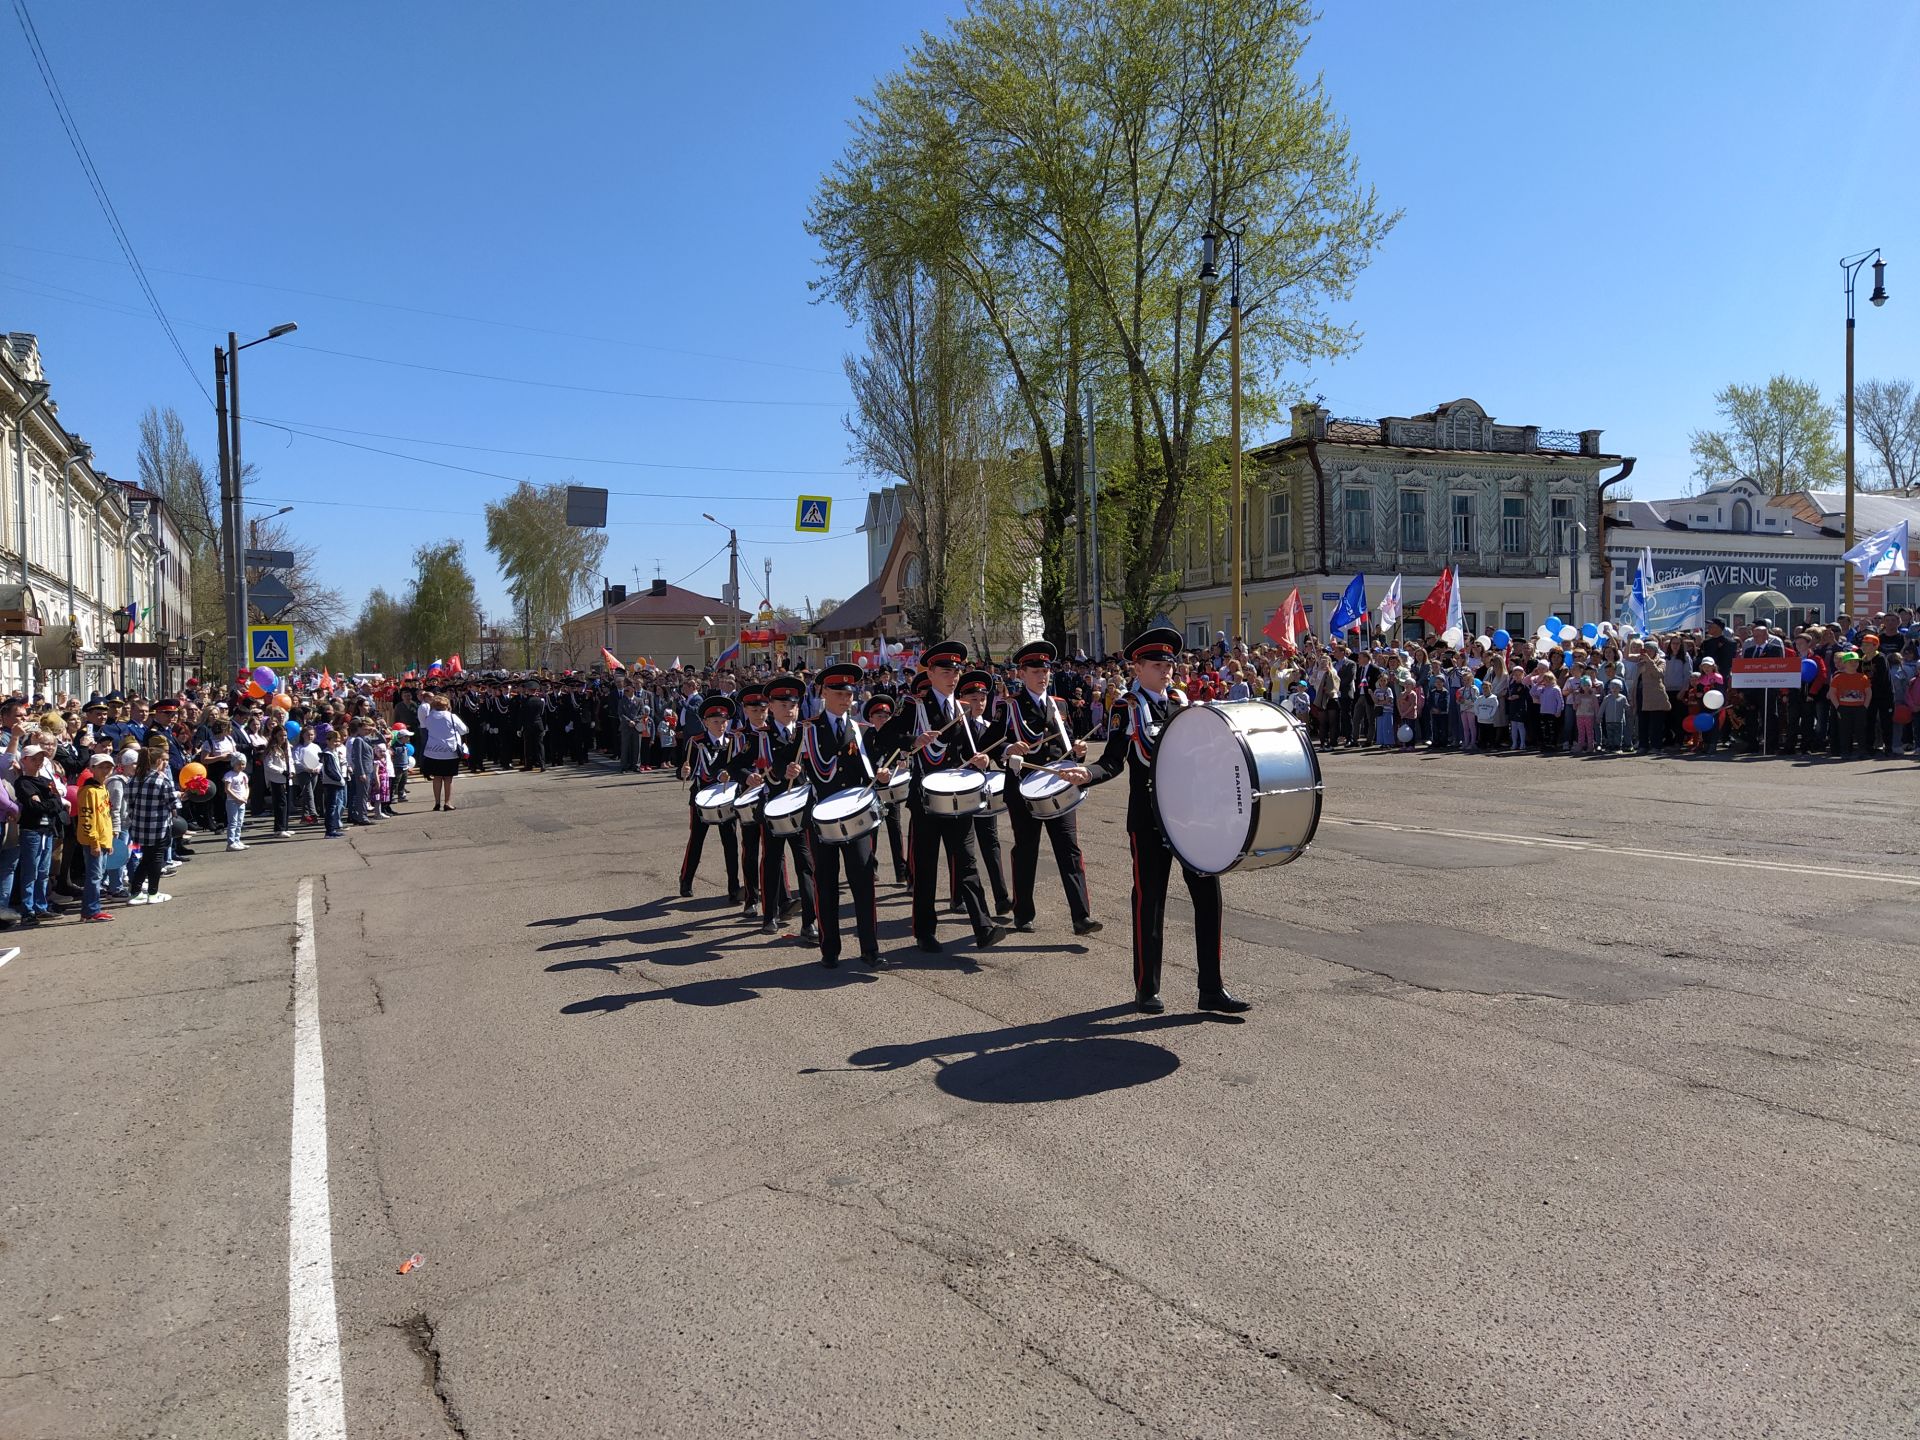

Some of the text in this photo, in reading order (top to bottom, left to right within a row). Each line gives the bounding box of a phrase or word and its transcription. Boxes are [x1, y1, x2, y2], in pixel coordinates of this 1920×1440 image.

[1704, 566, 1777, 589] AVENUE
[1787, 571, 1819, 590] кафе
[1235, 765, 1243, 814] BRAHNER
